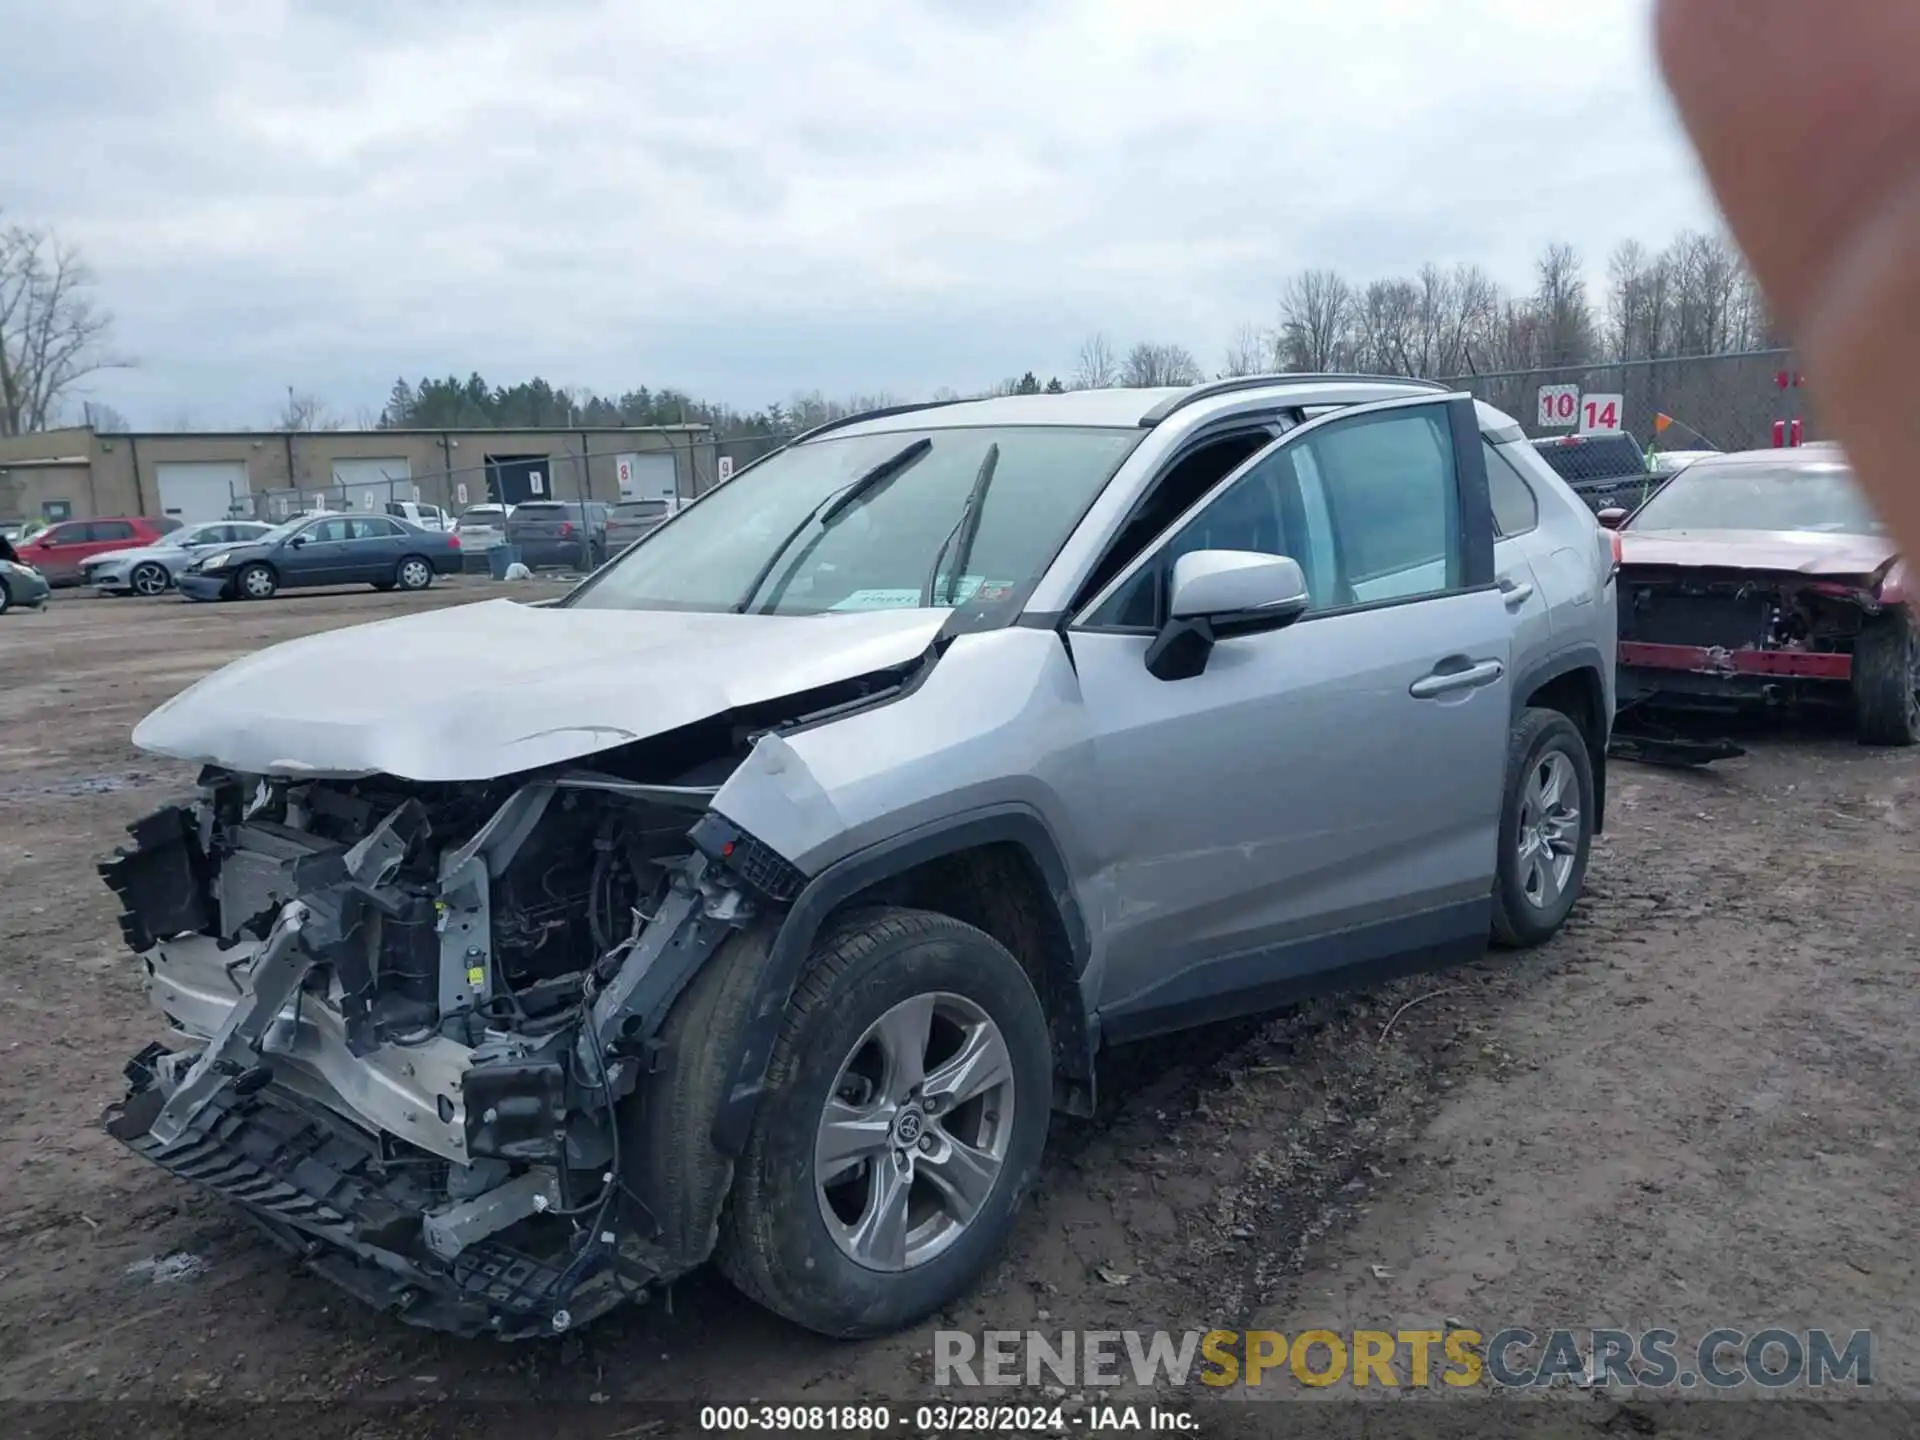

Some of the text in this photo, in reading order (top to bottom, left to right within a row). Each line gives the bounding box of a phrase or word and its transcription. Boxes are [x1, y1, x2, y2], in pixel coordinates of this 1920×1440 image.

[1543, 393, 1574, 418] 10
[1584, 402, 1617, 429] 14
[620, 464, 629, 480] 8
